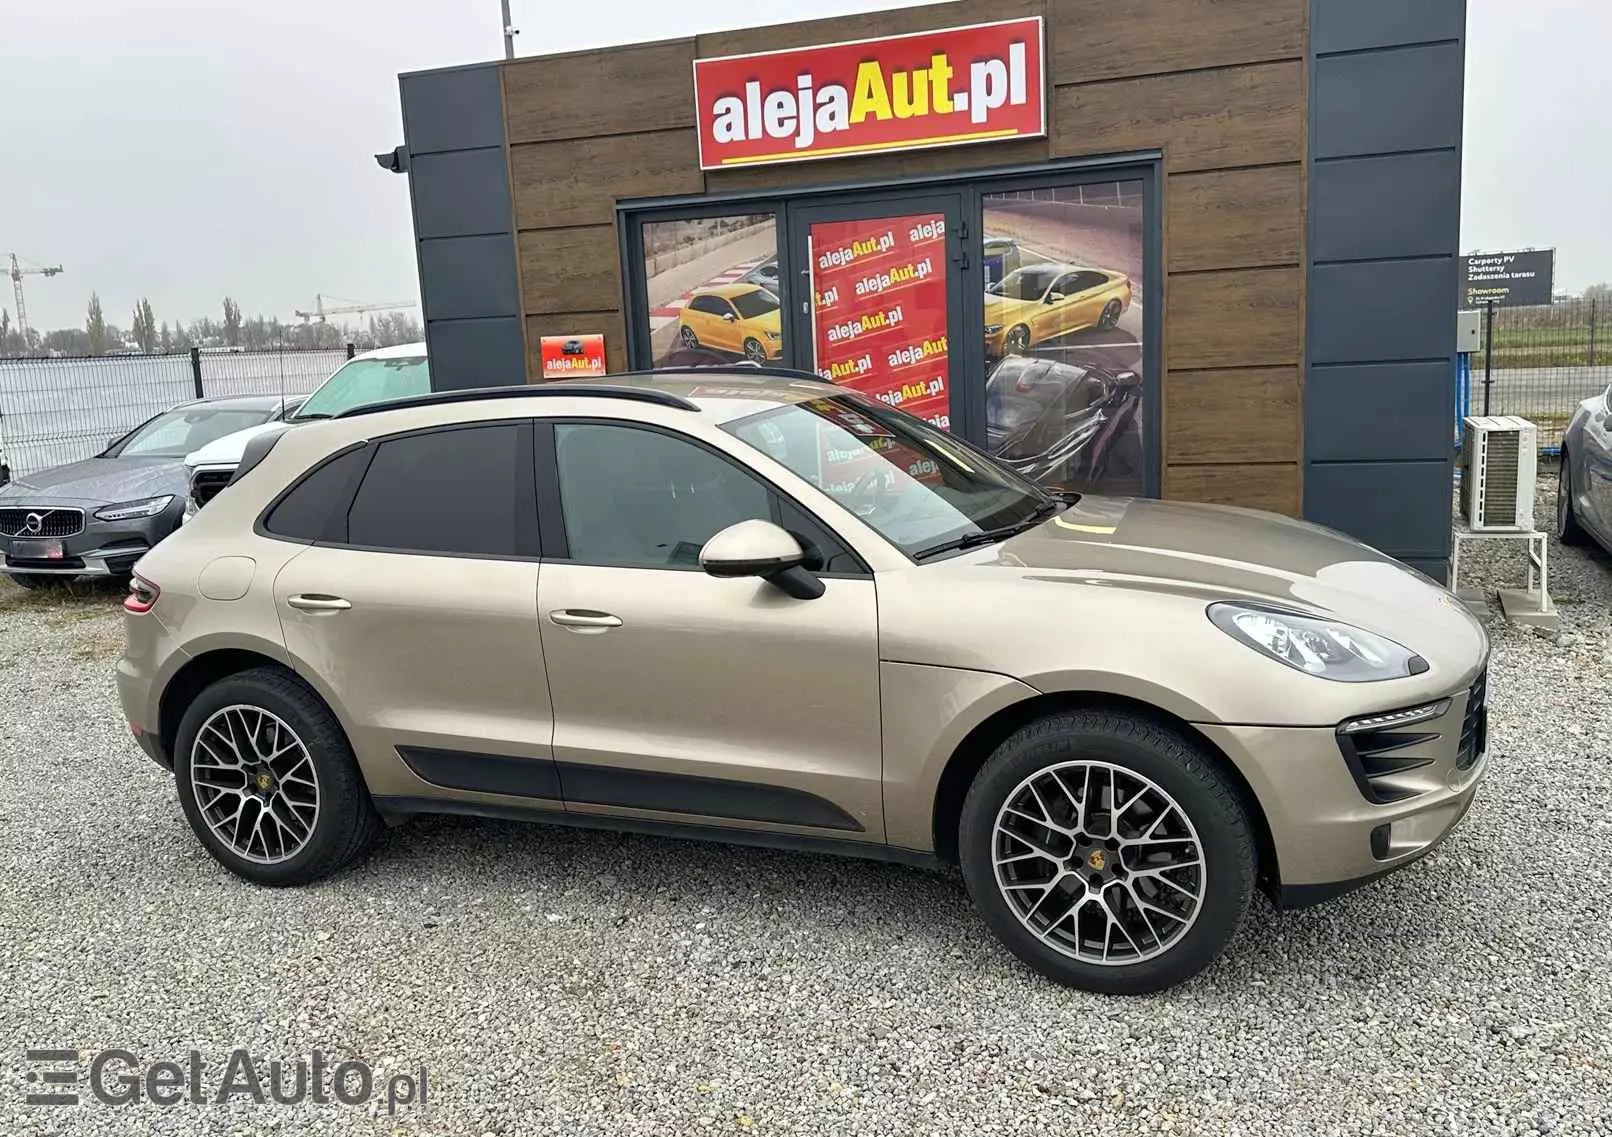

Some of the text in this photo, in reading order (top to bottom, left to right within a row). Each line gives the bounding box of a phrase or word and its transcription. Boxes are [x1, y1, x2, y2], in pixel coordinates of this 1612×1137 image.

[712, 42, 1027, 148] alejaAut.pl
[909, 220, 945, 242] aleja
[819, 231, 895, 269] alejaAut.pl
[1468, 255, 1515, 266] Carporty PV
[855, 258, 932, 295] alejaAut.pl
[1468, 271, 1536, 281] Zadaszenia tarasu
[1467, 287, 1510, 295] Showroom
[827, 306, 903, 342] alejaAut.pl
[546, 356, 602, 372] alejaAut.pl
